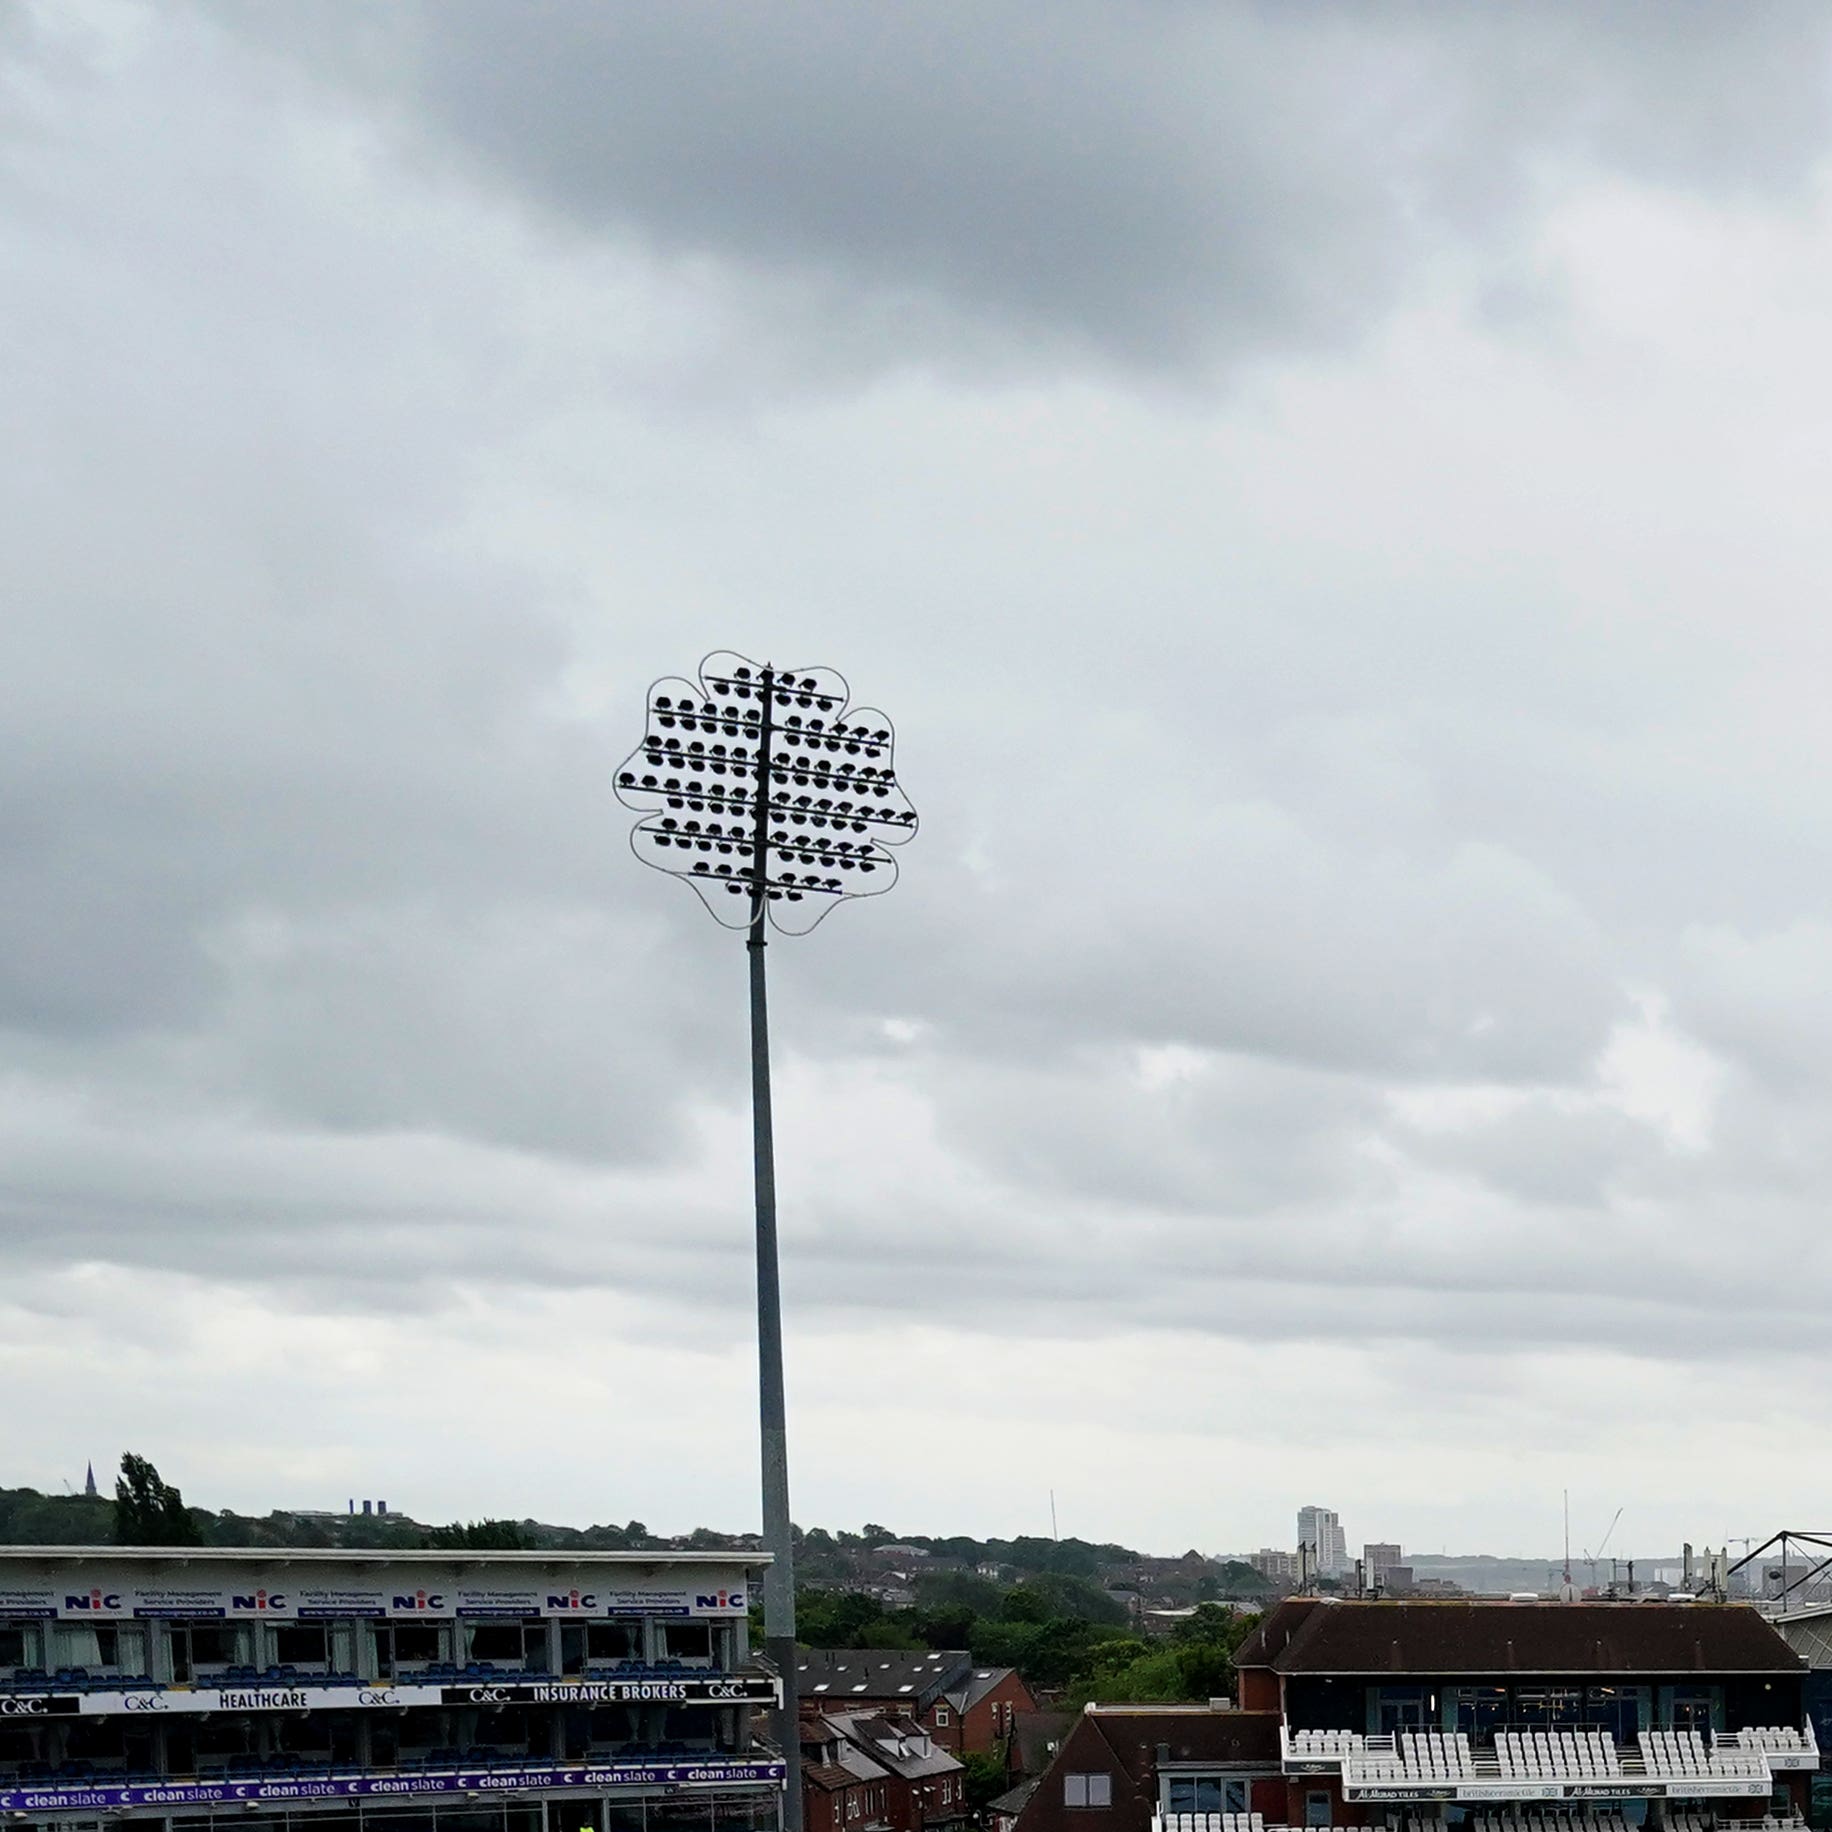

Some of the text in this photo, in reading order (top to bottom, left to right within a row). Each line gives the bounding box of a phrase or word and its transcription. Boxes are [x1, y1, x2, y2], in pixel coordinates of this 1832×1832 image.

[219, 1692, 308, 1709] HEALTHCARE
[534, 1684, 687, 1701] INSURANCE BROKERS
[479, 1771, 551, 1788] clean slate
[688, 1766, 757, 1780] clean slate
[144, 1786, 223, 1802] clean slate
[259, 1781, 335, 1797] clean slate
